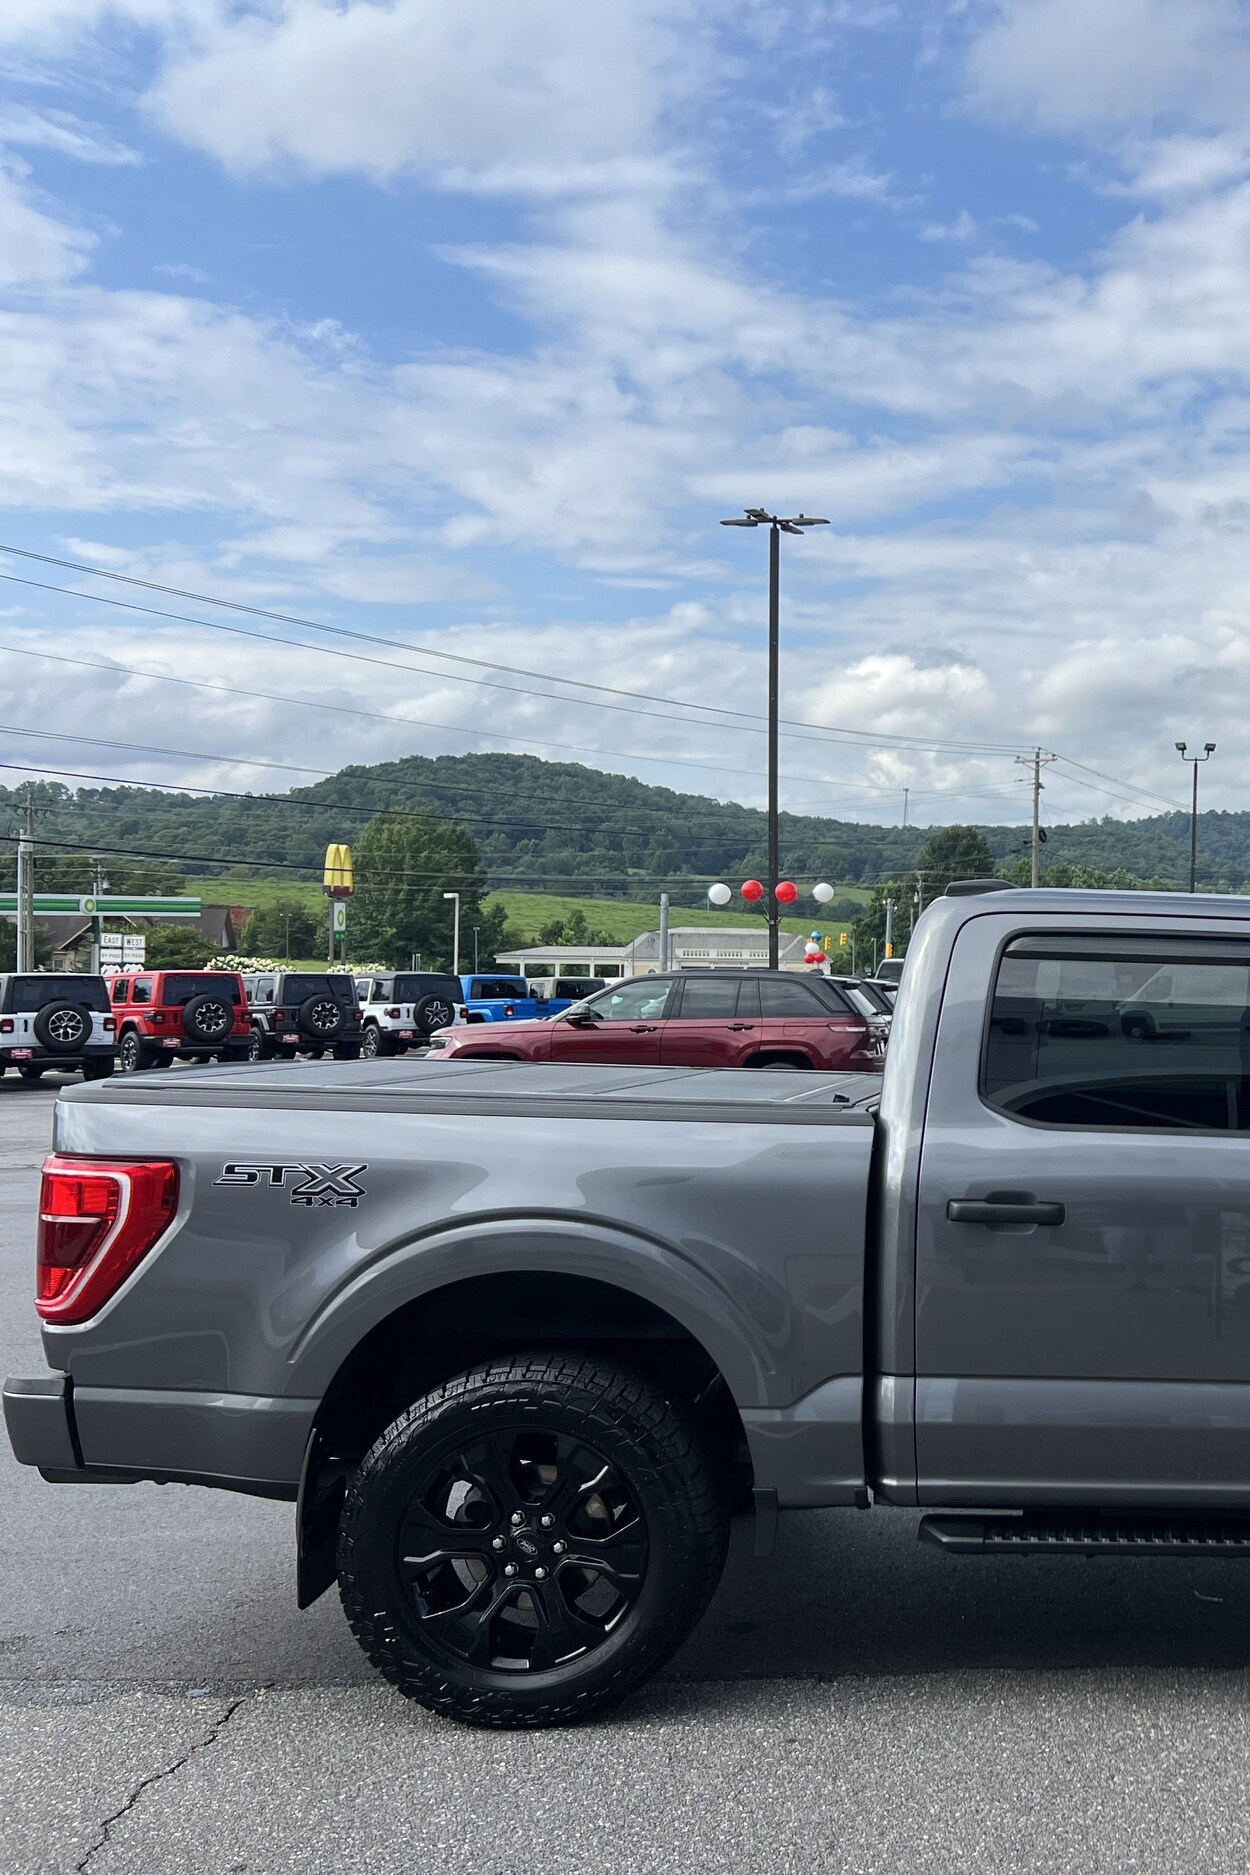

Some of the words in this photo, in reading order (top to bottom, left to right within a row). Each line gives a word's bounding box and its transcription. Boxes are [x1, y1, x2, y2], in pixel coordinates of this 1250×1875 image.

[103, 935, 120, 945] EAST
[126, 938, 143, 947] WEST
[212, 1160, 368, 1197] STX
